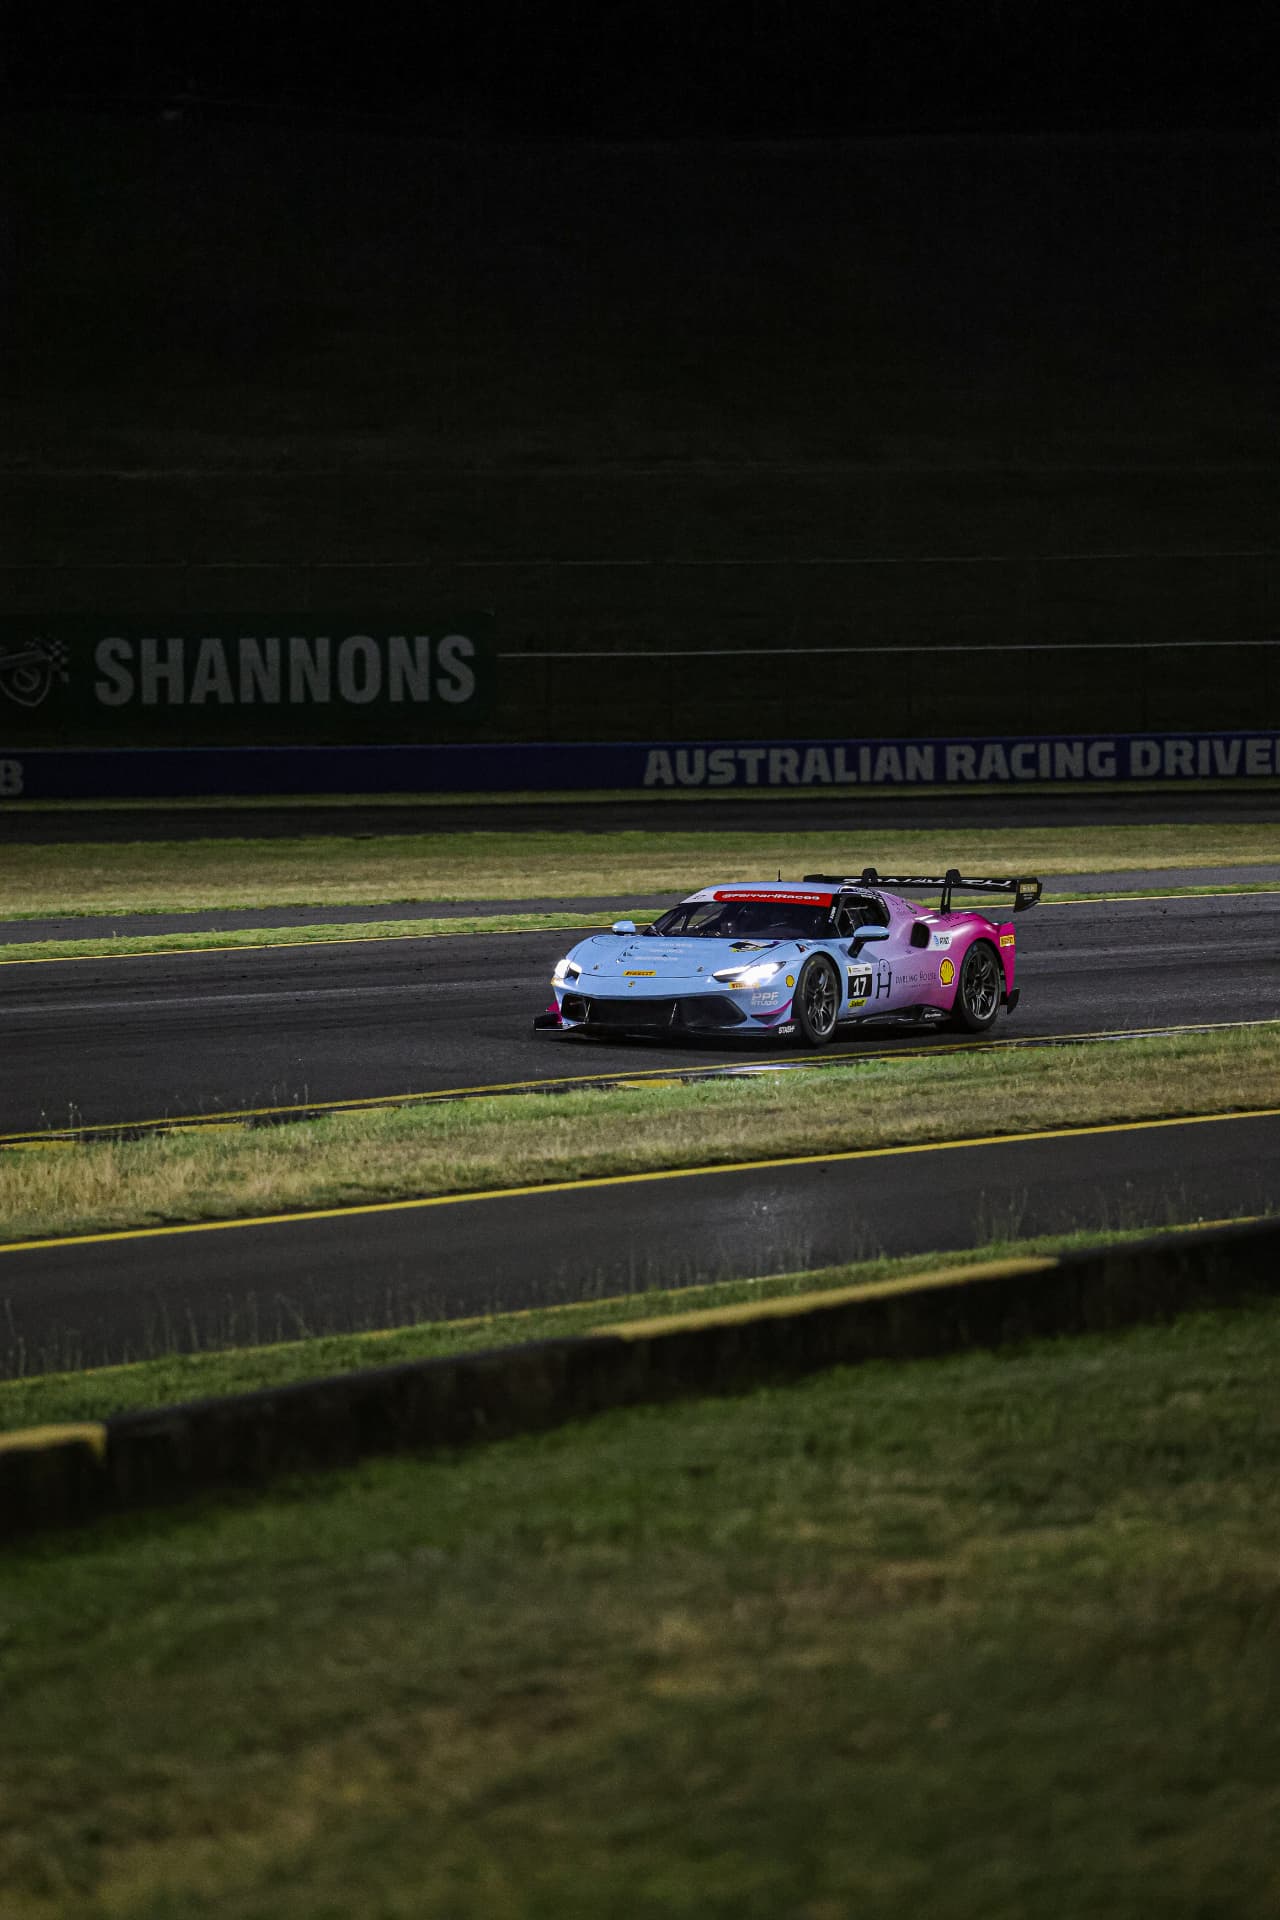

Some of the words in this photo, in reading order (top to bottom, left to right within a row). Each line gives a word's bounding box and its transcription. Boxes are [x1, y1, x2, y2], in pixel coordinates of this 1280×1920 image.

[94, 634, 476, 706] SHANNONS
[644, 744, 935, 786] AUSTRALIAN
[946, 741, 1117, 781] RACING
[1129, 738, 1280, 777] DRIVE
[853, 976, 867, 996] 17
[895, 974, 918, 984] DARLING
[752, 991, 779, 1000] PPF
